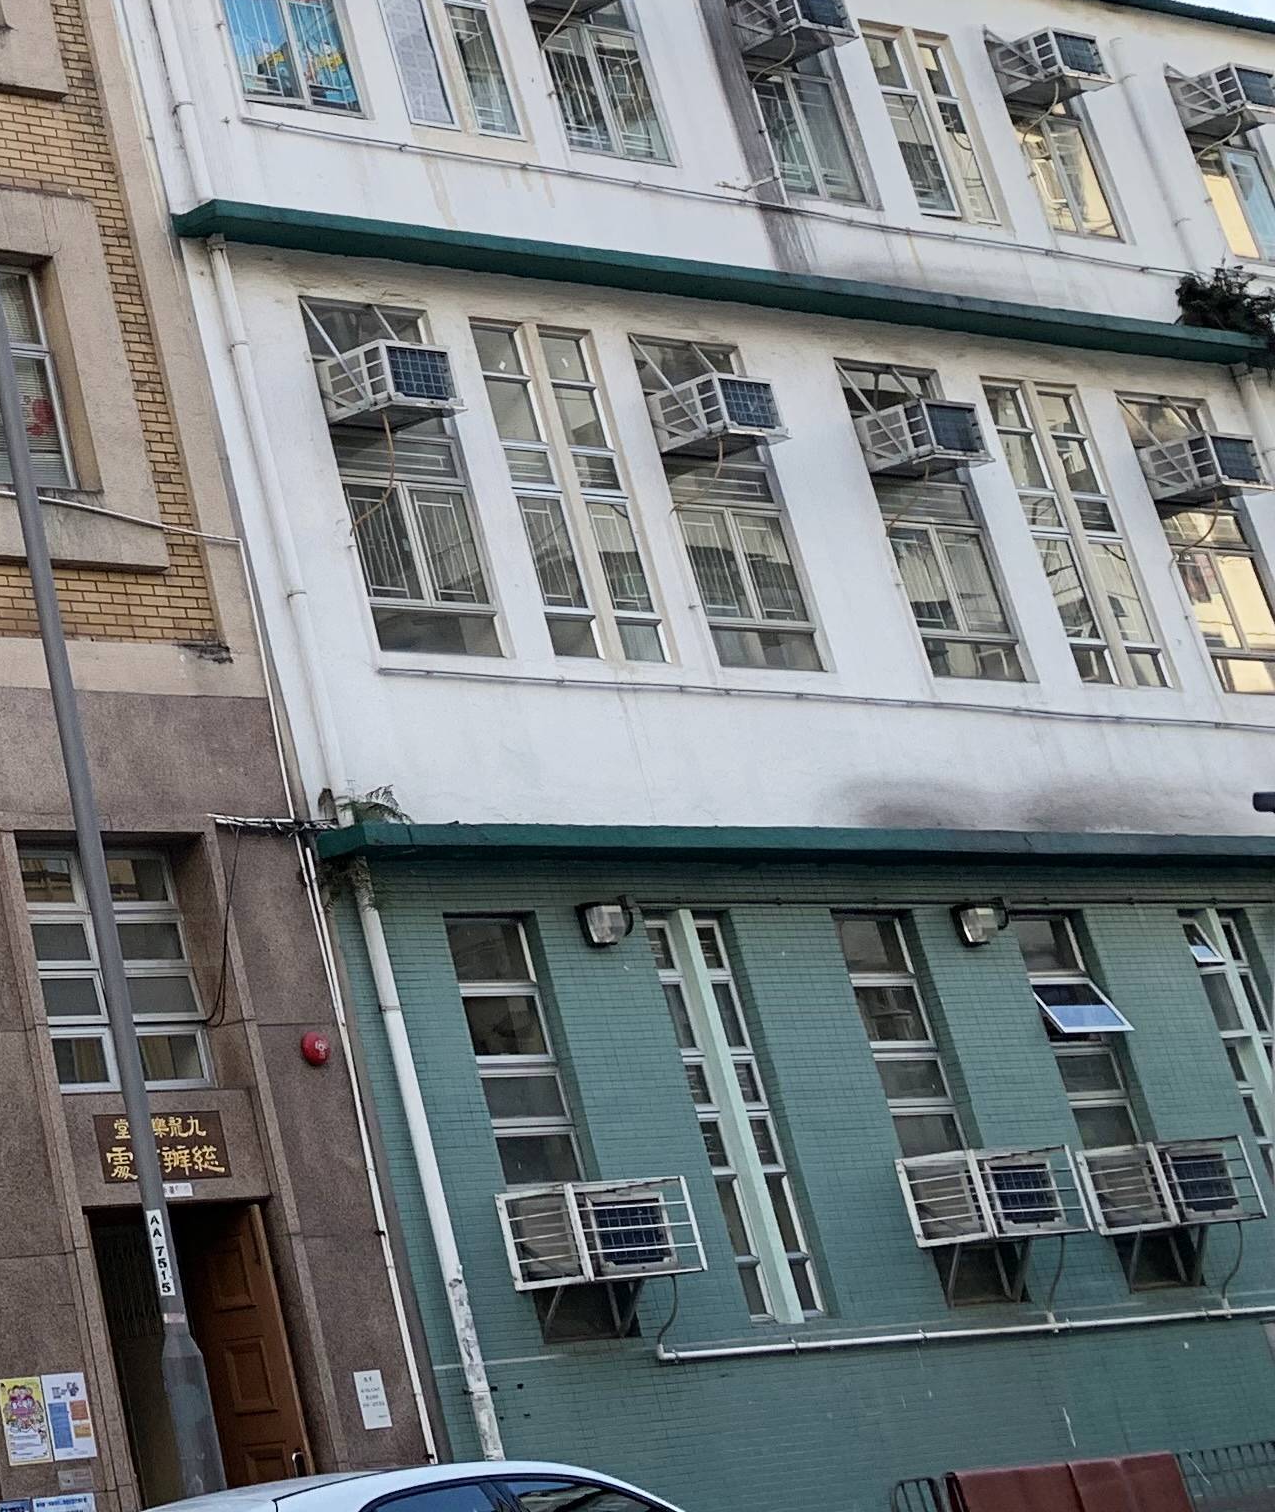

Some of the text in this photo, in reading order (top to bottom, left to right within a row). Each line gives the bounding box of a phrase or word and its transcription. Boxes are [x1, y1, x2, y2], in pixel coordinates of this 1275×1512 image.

[113, 1115, 207, 1140] 九龍樂堂
[154, 1246, 172, 1293] 7515
